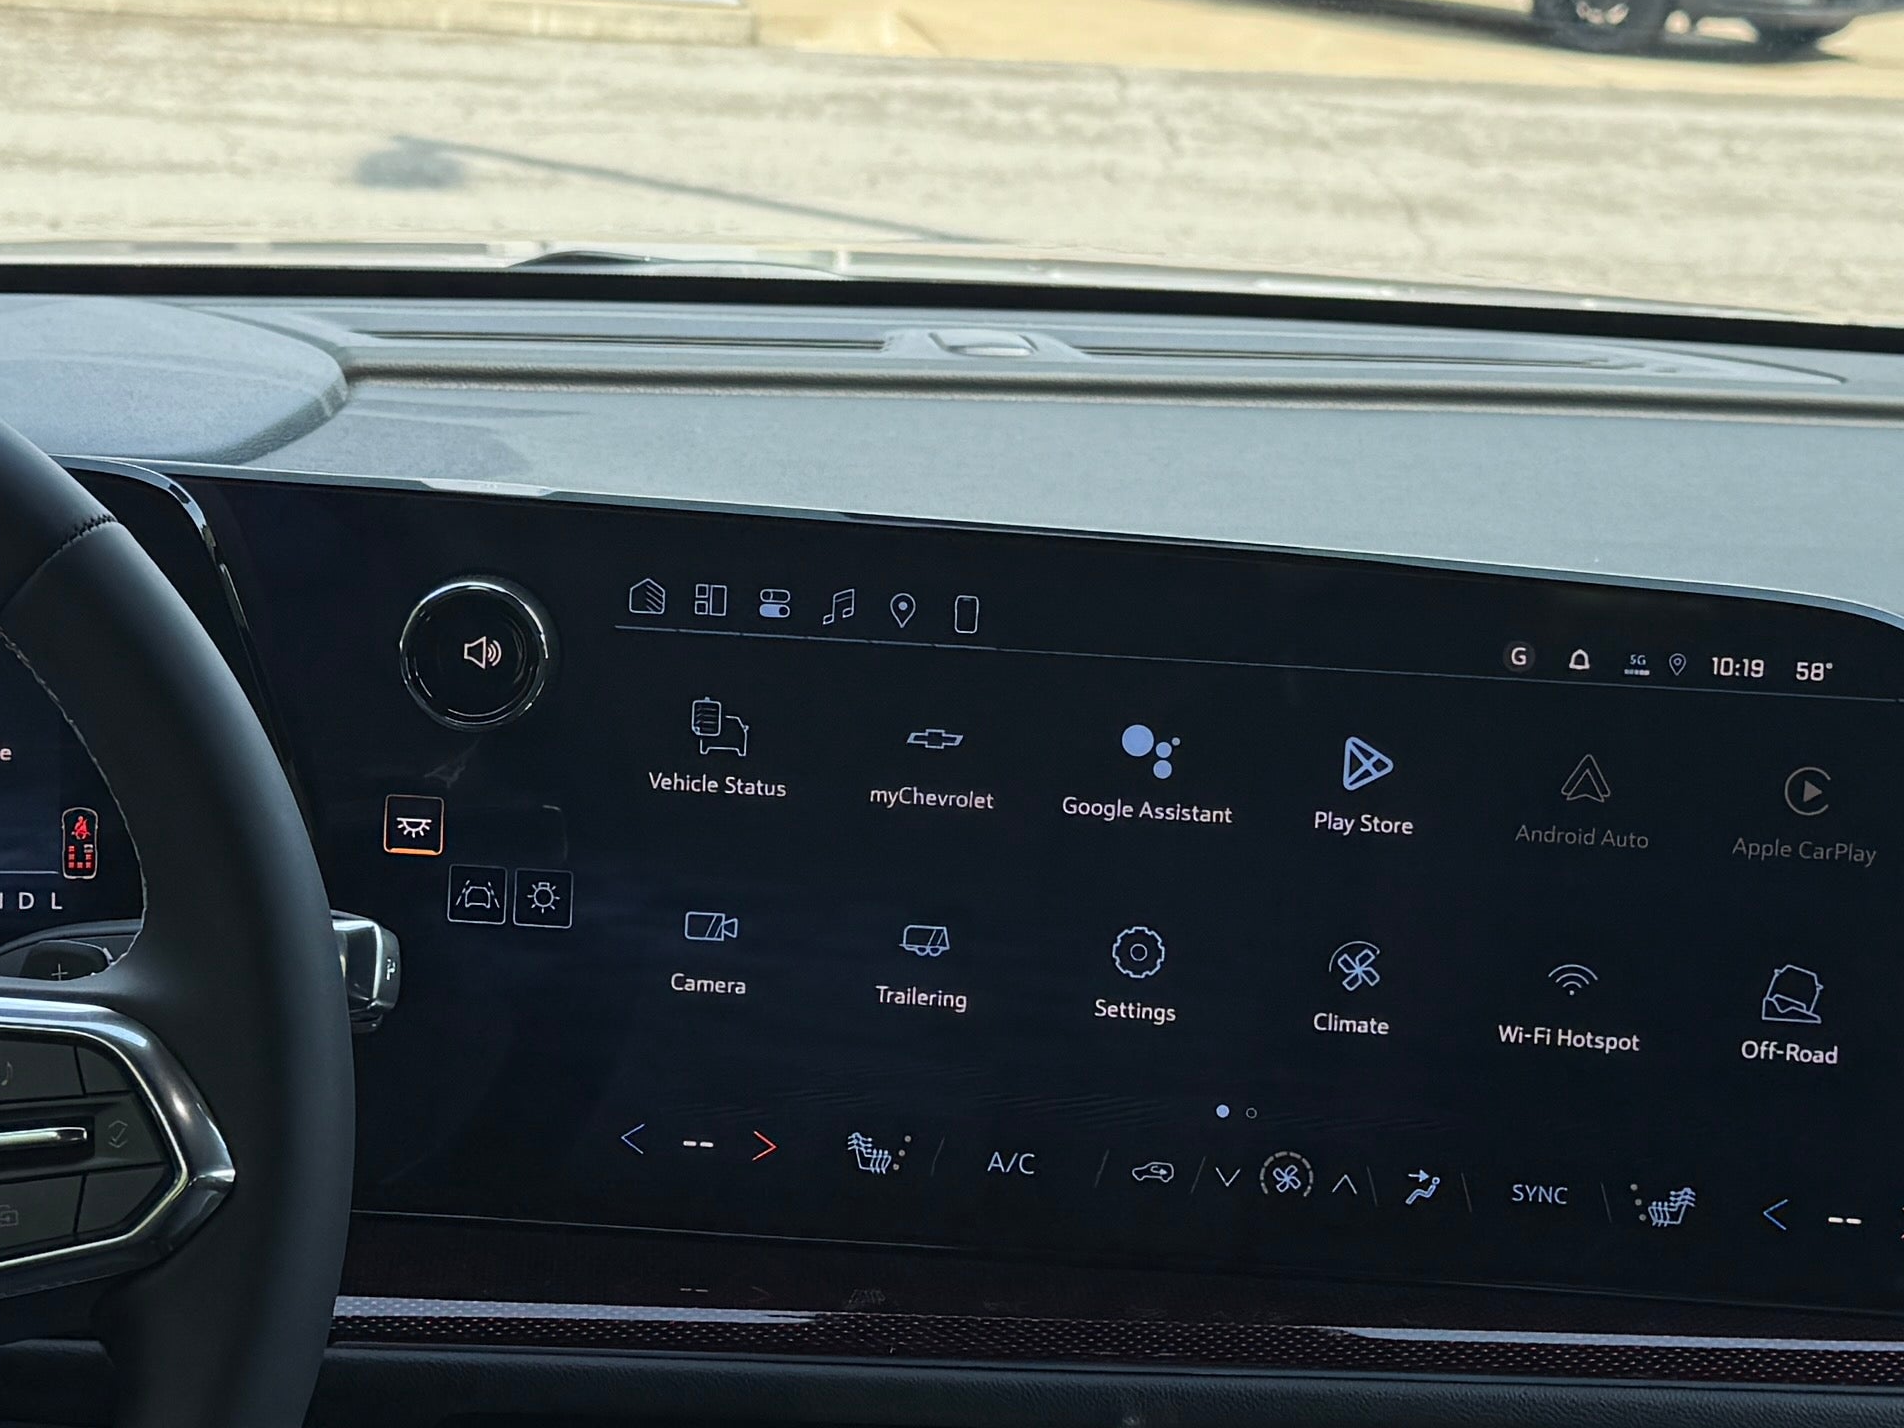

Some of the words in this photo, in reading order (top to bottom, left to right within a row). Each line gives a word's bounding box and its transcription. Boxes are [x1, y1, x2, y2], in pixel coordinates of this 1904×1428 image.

[1628, 652, 1647, 668] 5G
[1711, 656, 1765, 678] 10:19
[1795, 661, 1833, 682] 58°
[648, 771, 719, 793] Vehicle
[724, 776, 787, 797] Status
[870, 786, 994, 810] myChevrolet
[1062, 796, 1134, 822] Google
[1138, 801, 1233, 824] Assistant
[1314, 810, 1356, 836] Play
[1359, 814, 1414, 835] Store
[1514, 824, 1596, 846] Android
[1600, 829, 1649, 849] Auto
[1731, 837, 1792, 861] Apple
[1798, 840, 1877, 868] CarPlay
[18, 891, 35, 910] D
[51, 891, 63, 910] L
[670, 972, 746, 995] Camera
[875, 985, 967, 1013] Trailering
[1094, 998, 1176, 1026] Settings
[1313, 1012, 1390, 1035] Climate
[1498, 1024, 1552, 1045] Wi-Fi
[1557, 1028, 1640, 1054] Hotspot
[1741, 1040, 1838, 1065] Off-Road
[987, 1151, 1035, 1175] A/C
[1511, 1183, 1568, 1205] SYNC
